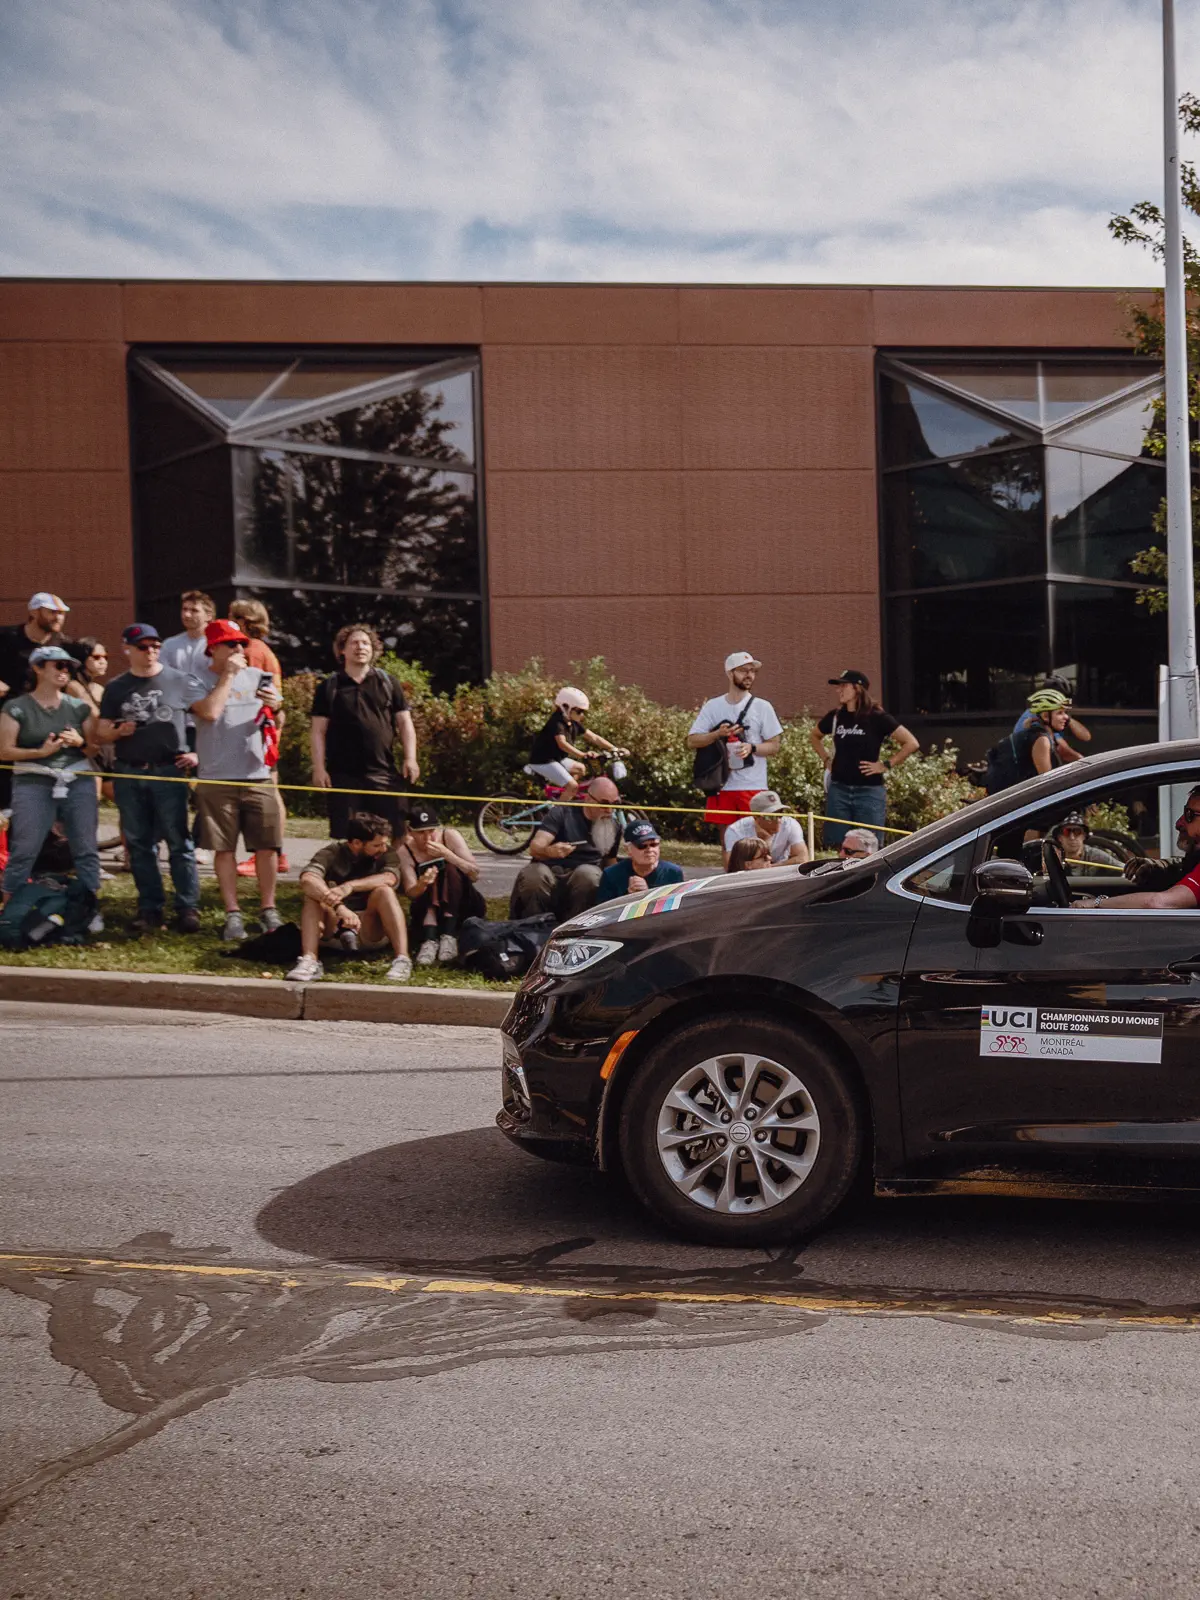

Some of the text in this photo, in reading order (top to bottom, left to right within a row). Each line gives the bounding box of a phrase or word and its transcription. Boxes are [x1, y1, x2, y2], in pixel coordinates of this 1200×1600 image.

[420, 812, 429, 822] C
[991, 1010, 1033, 1029] UCI
[1040, 1012, 1160, 1026] CHAMPIONNATS DU MONDE
[1040, 1022, 1090, 1032] ROUTE 2026
[1040, 1037, 1086, 1048] MONTRÉAL
[1039, 1046, 1074, 1056] CANADA
